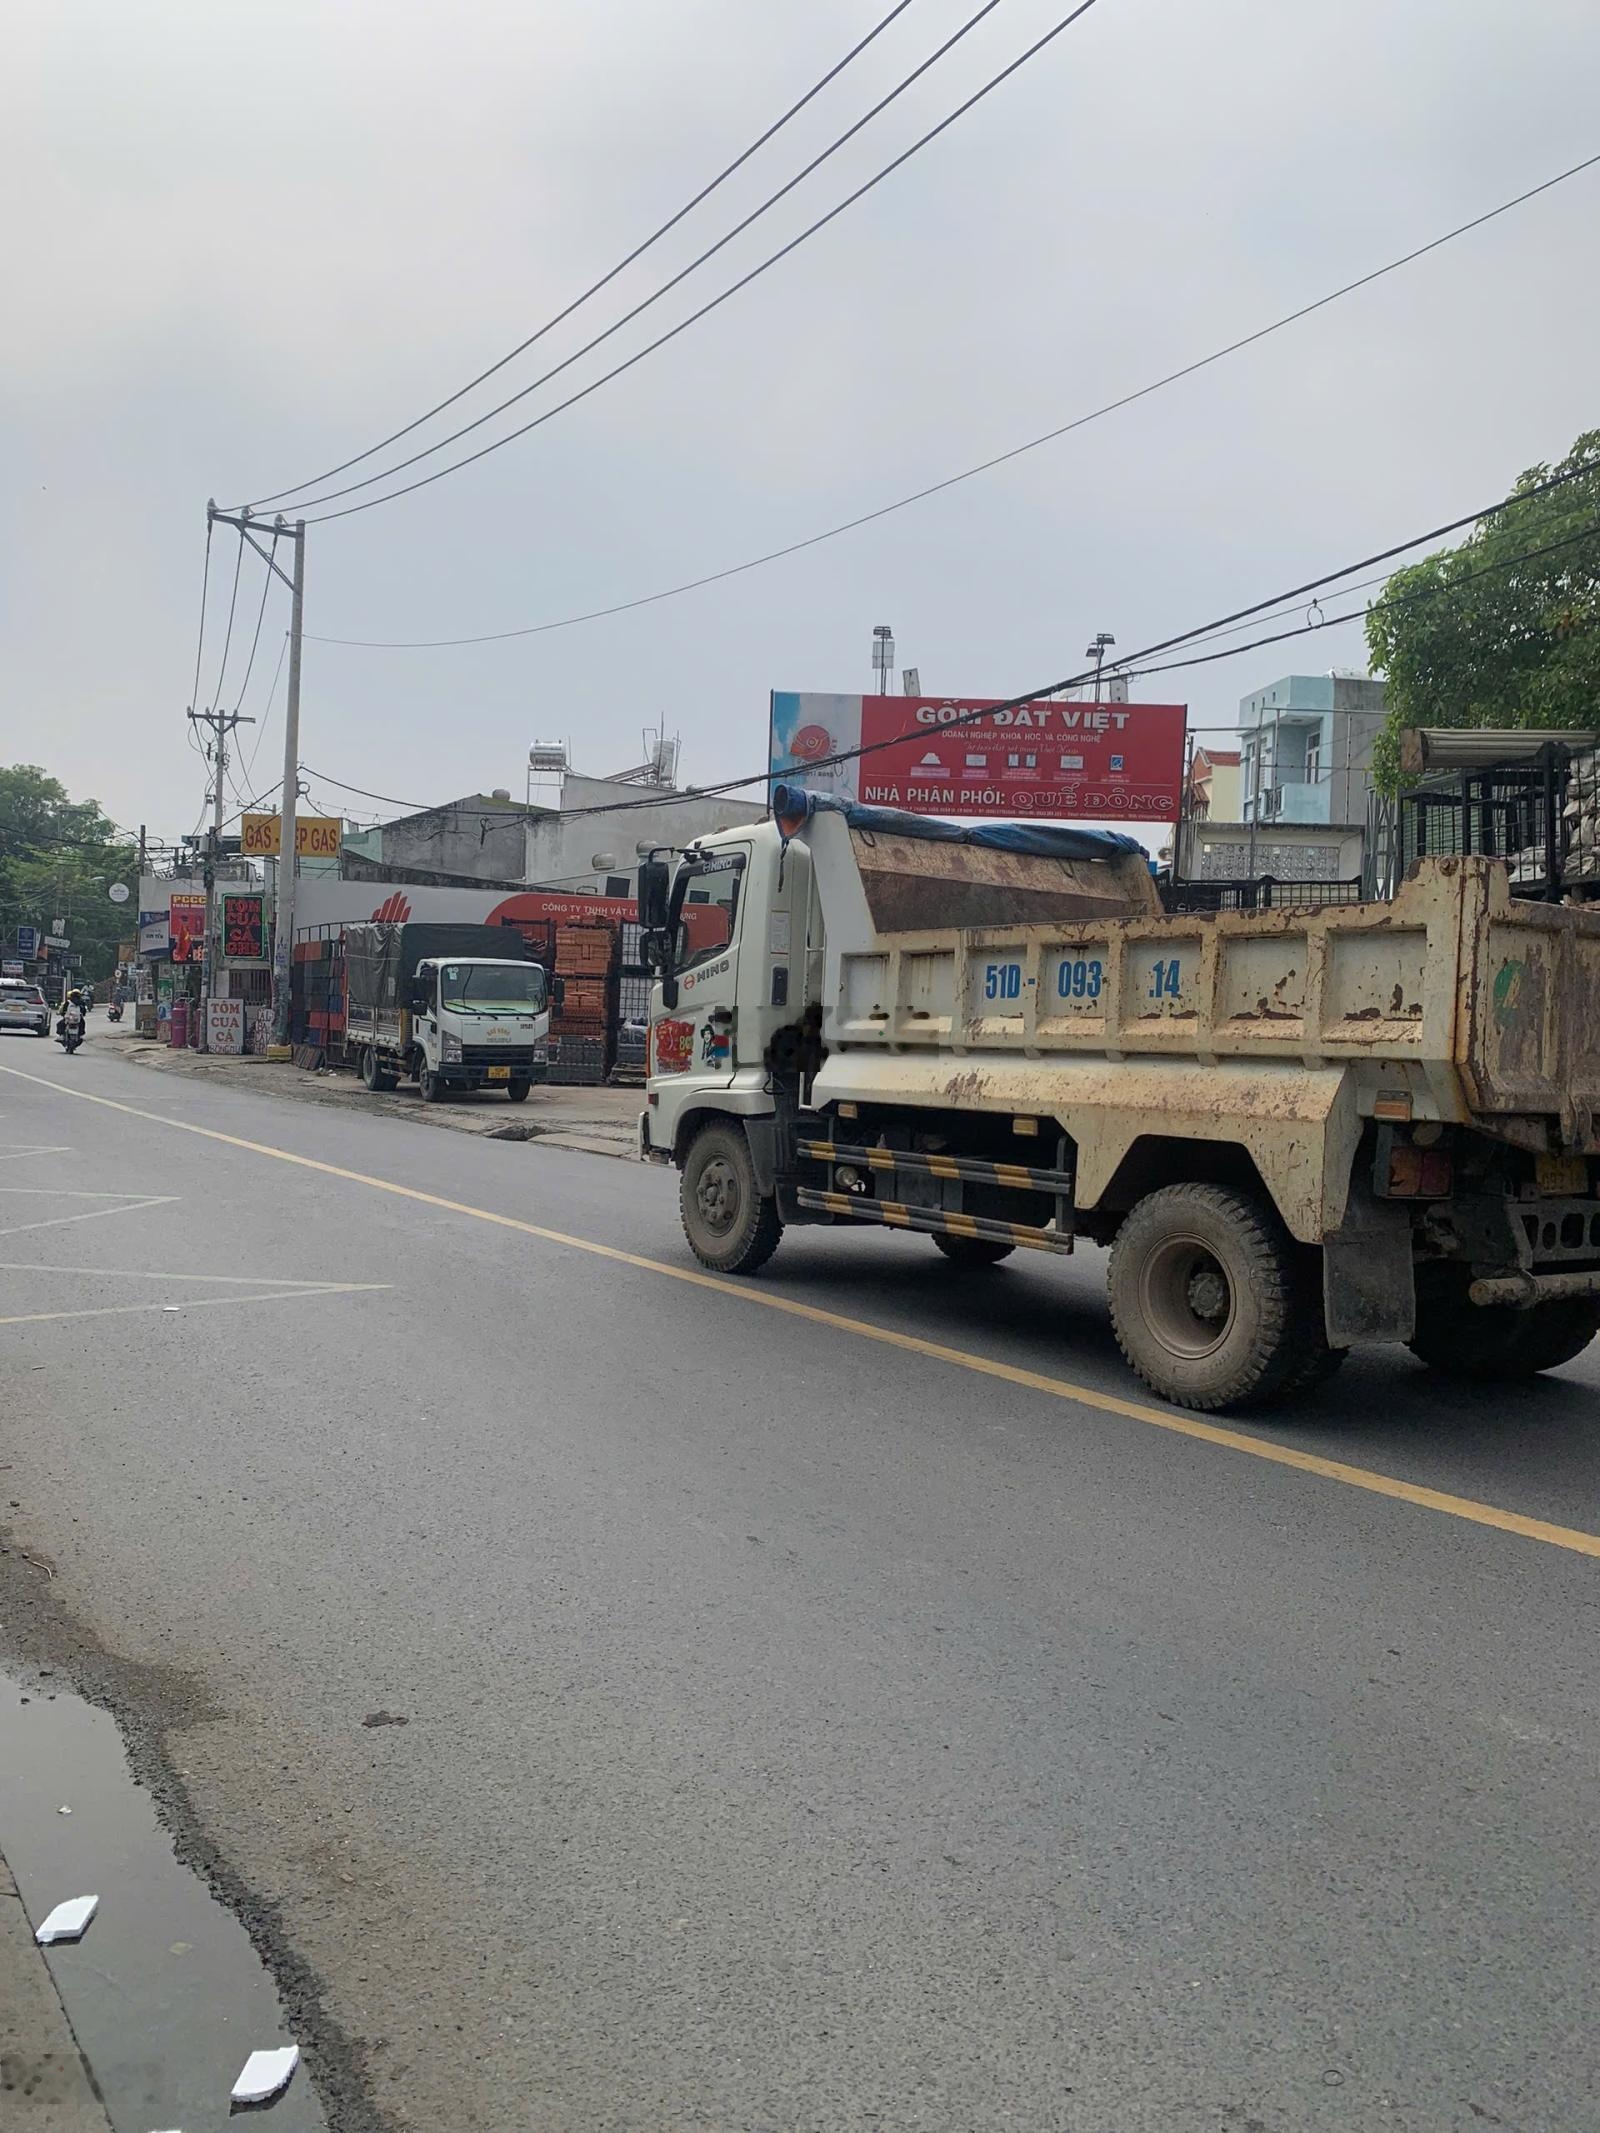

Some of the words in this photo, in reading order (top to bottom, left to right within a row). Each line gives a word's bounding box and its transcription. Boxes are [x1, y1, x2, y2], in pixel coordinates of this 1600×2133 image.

[915, 699, 982, 725] GỐM
[1061, 706, 1130, 733] VIỆT
[864, 784, 900, 802] NHÀ
[906, 785, 954, 804] PHÂN
[960, 785, 1005, 805] PHỐI:
[1011, 782, 1078, 810] QUẾ
[311, 827, 337, 853] GAS
[173, 895, 207, 905] PCCC
[541, 902, 568, 912] CÔNG
[569, 904, 581, 913] TY
[696, 959, 730, 983] HINO
[1057, 959, 1102, 998] 093
[211, 1017, 240, 1028] CUA
